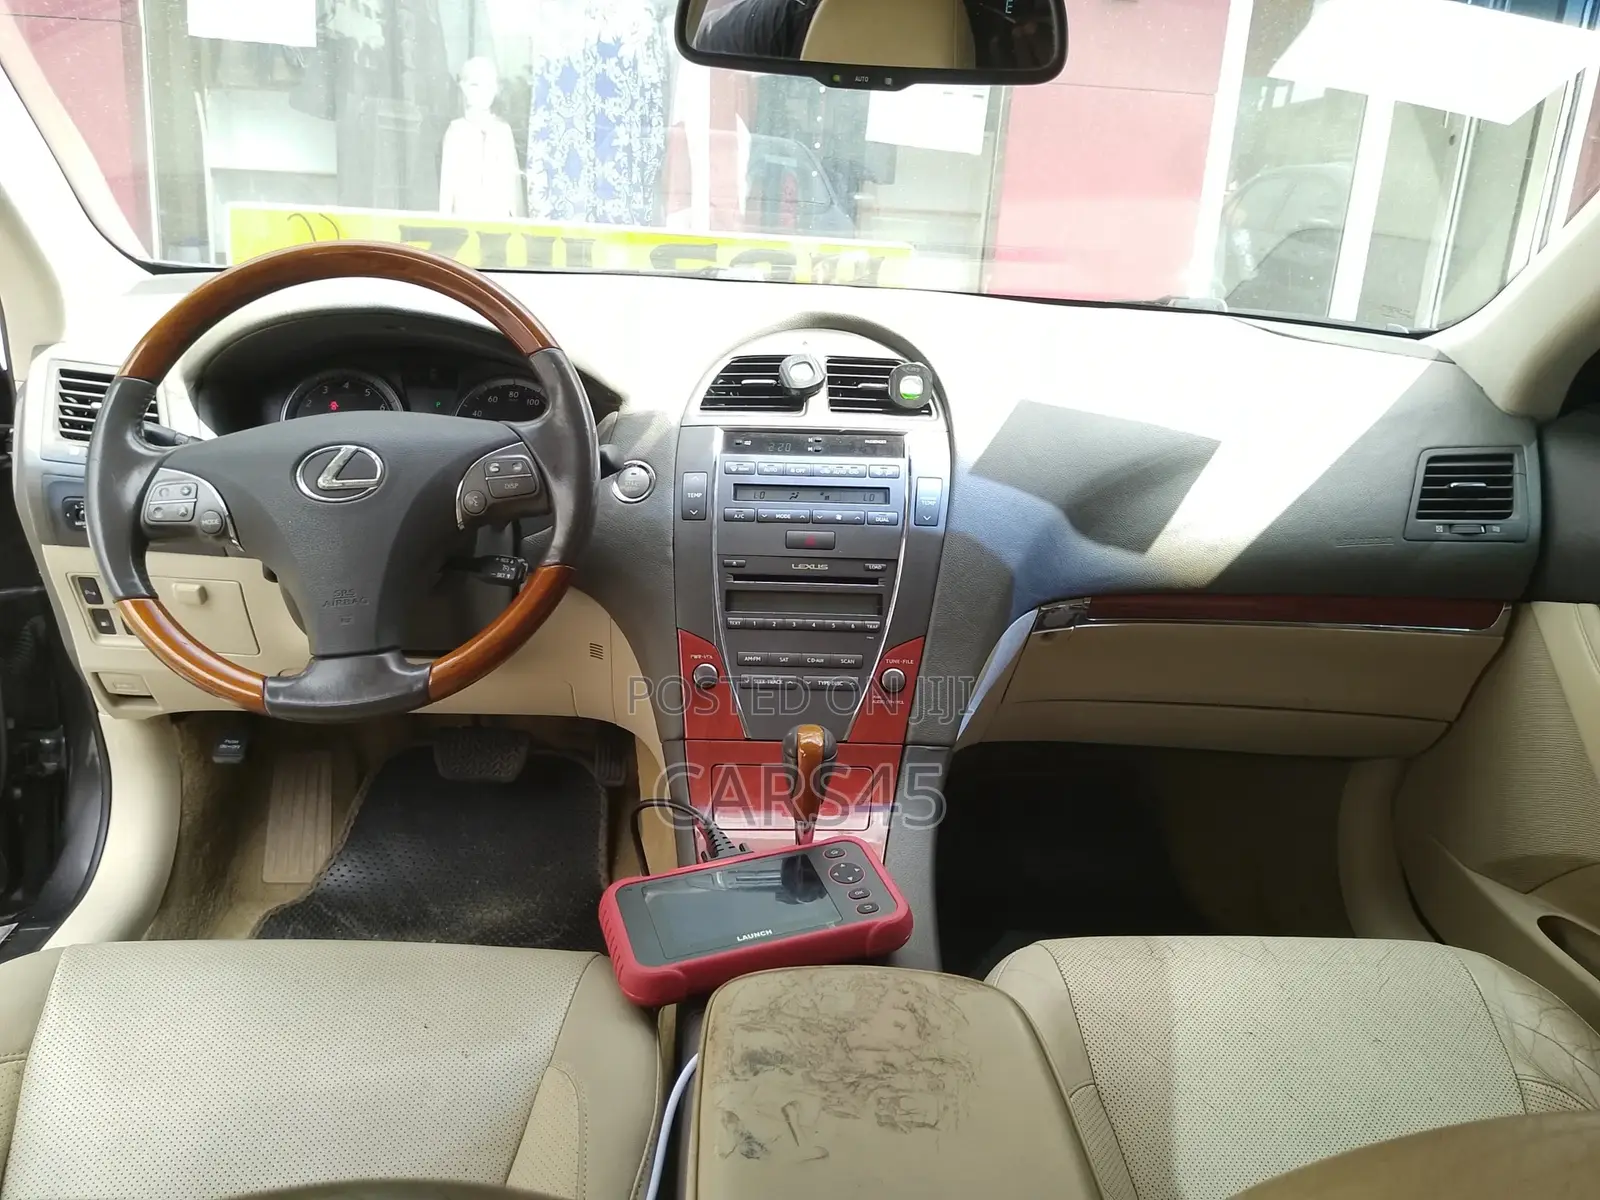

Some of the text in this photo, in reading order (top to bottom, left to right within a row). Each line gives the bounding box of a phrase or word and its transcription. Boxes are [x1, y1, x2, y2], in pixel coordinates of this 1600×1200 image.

[854, 75, 869, 83] AUTO
[322, 386, 329, 394] 3
[364, 389, 371, 397] 5
[487, 395, 499, 403] 60
[508, 391, 519, 399] 80
[305, 400, 312, 408] 2
[526, 398, 540, 406] 100
[379, 403, 386, 411] 6
[736, 928, 773, 942] LAUNCH
